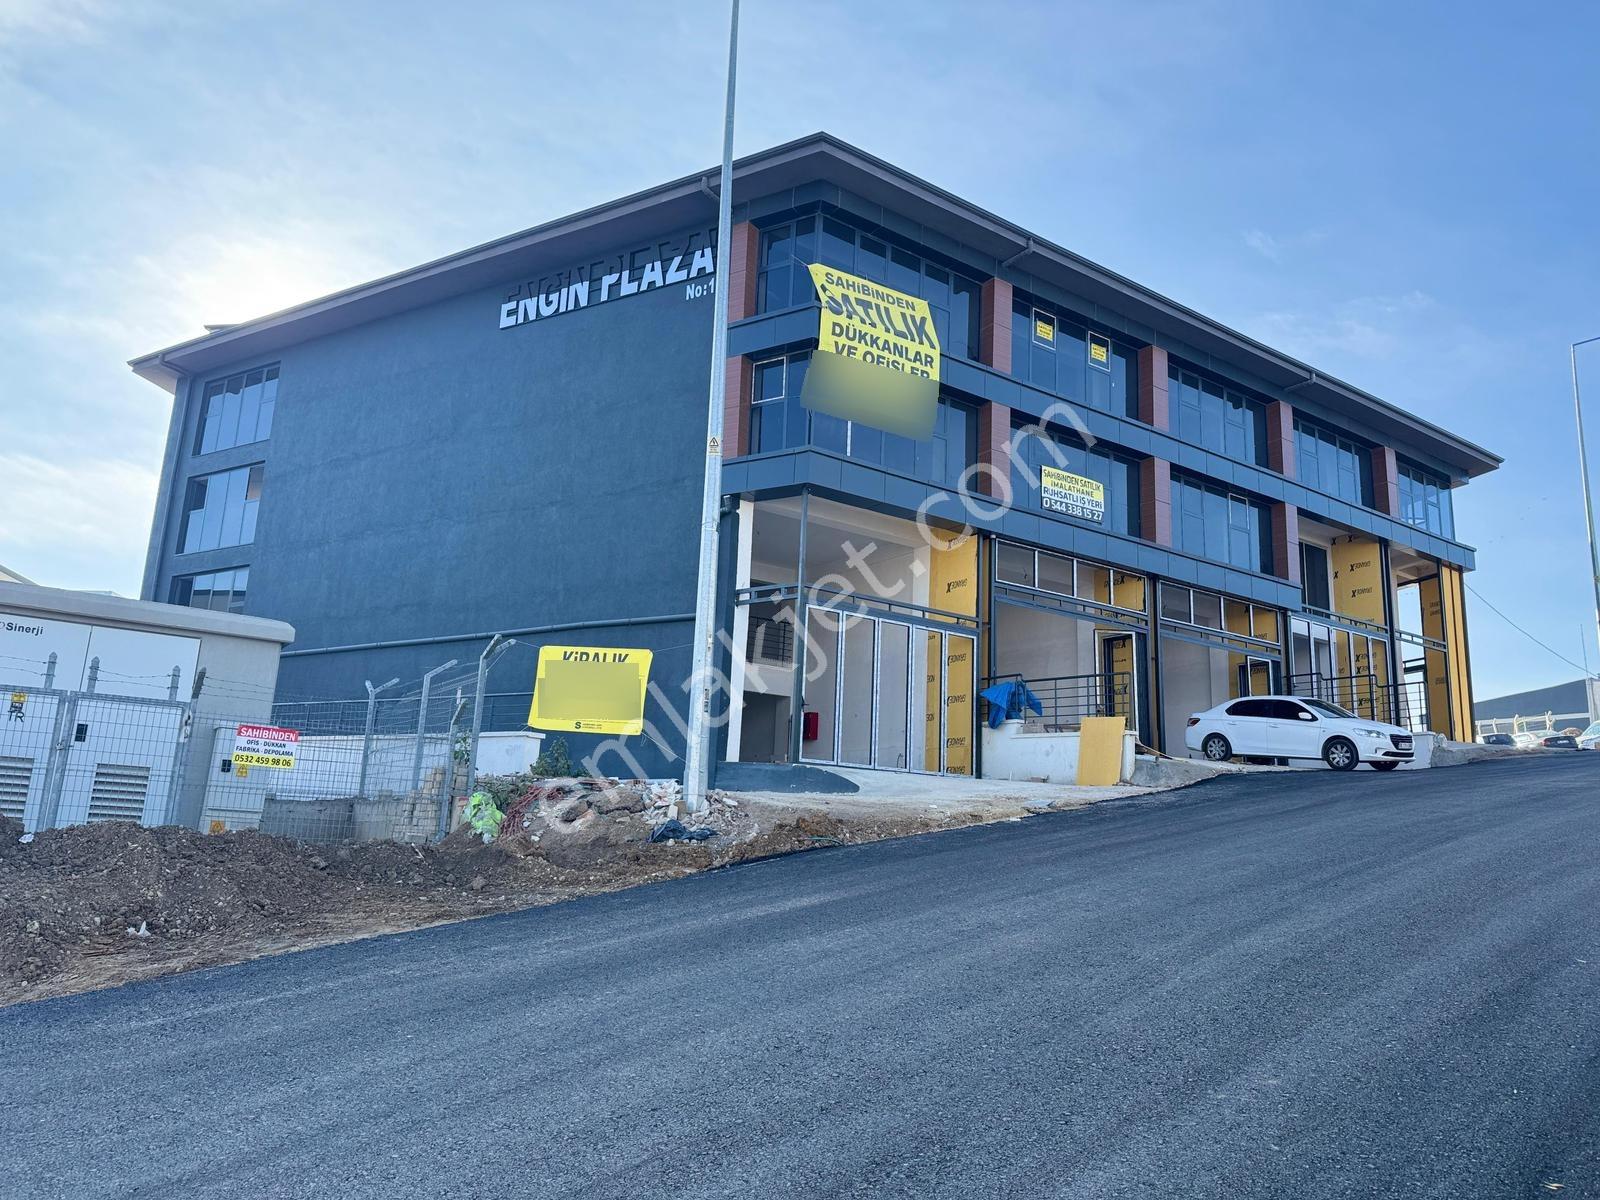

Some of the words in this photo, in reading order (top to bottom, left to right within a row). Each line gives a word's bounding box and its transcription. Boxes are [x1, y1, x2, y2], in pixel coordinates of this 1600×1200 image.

[600, 237, 714, 302] PLAZA
[820, 284, 936, 350] SATILIK
[831, 321, 934, 369] DÜKKANLAR
[1043, 498, 1050, 507] 0
[1051, 500, 1066, 512] 544
[1067, 504, 1082, 516] 338
[1083, 509, 1091, 519] 15
[1092, 511, 1103, 521] 27
[6, 622, 44, 636] Sinerji
[234, 754, 254, 763] 0532
[255, 756, 269, 765] 459
[270, 758, 281, 766] 98
[281, 759, 291, 767] 06
